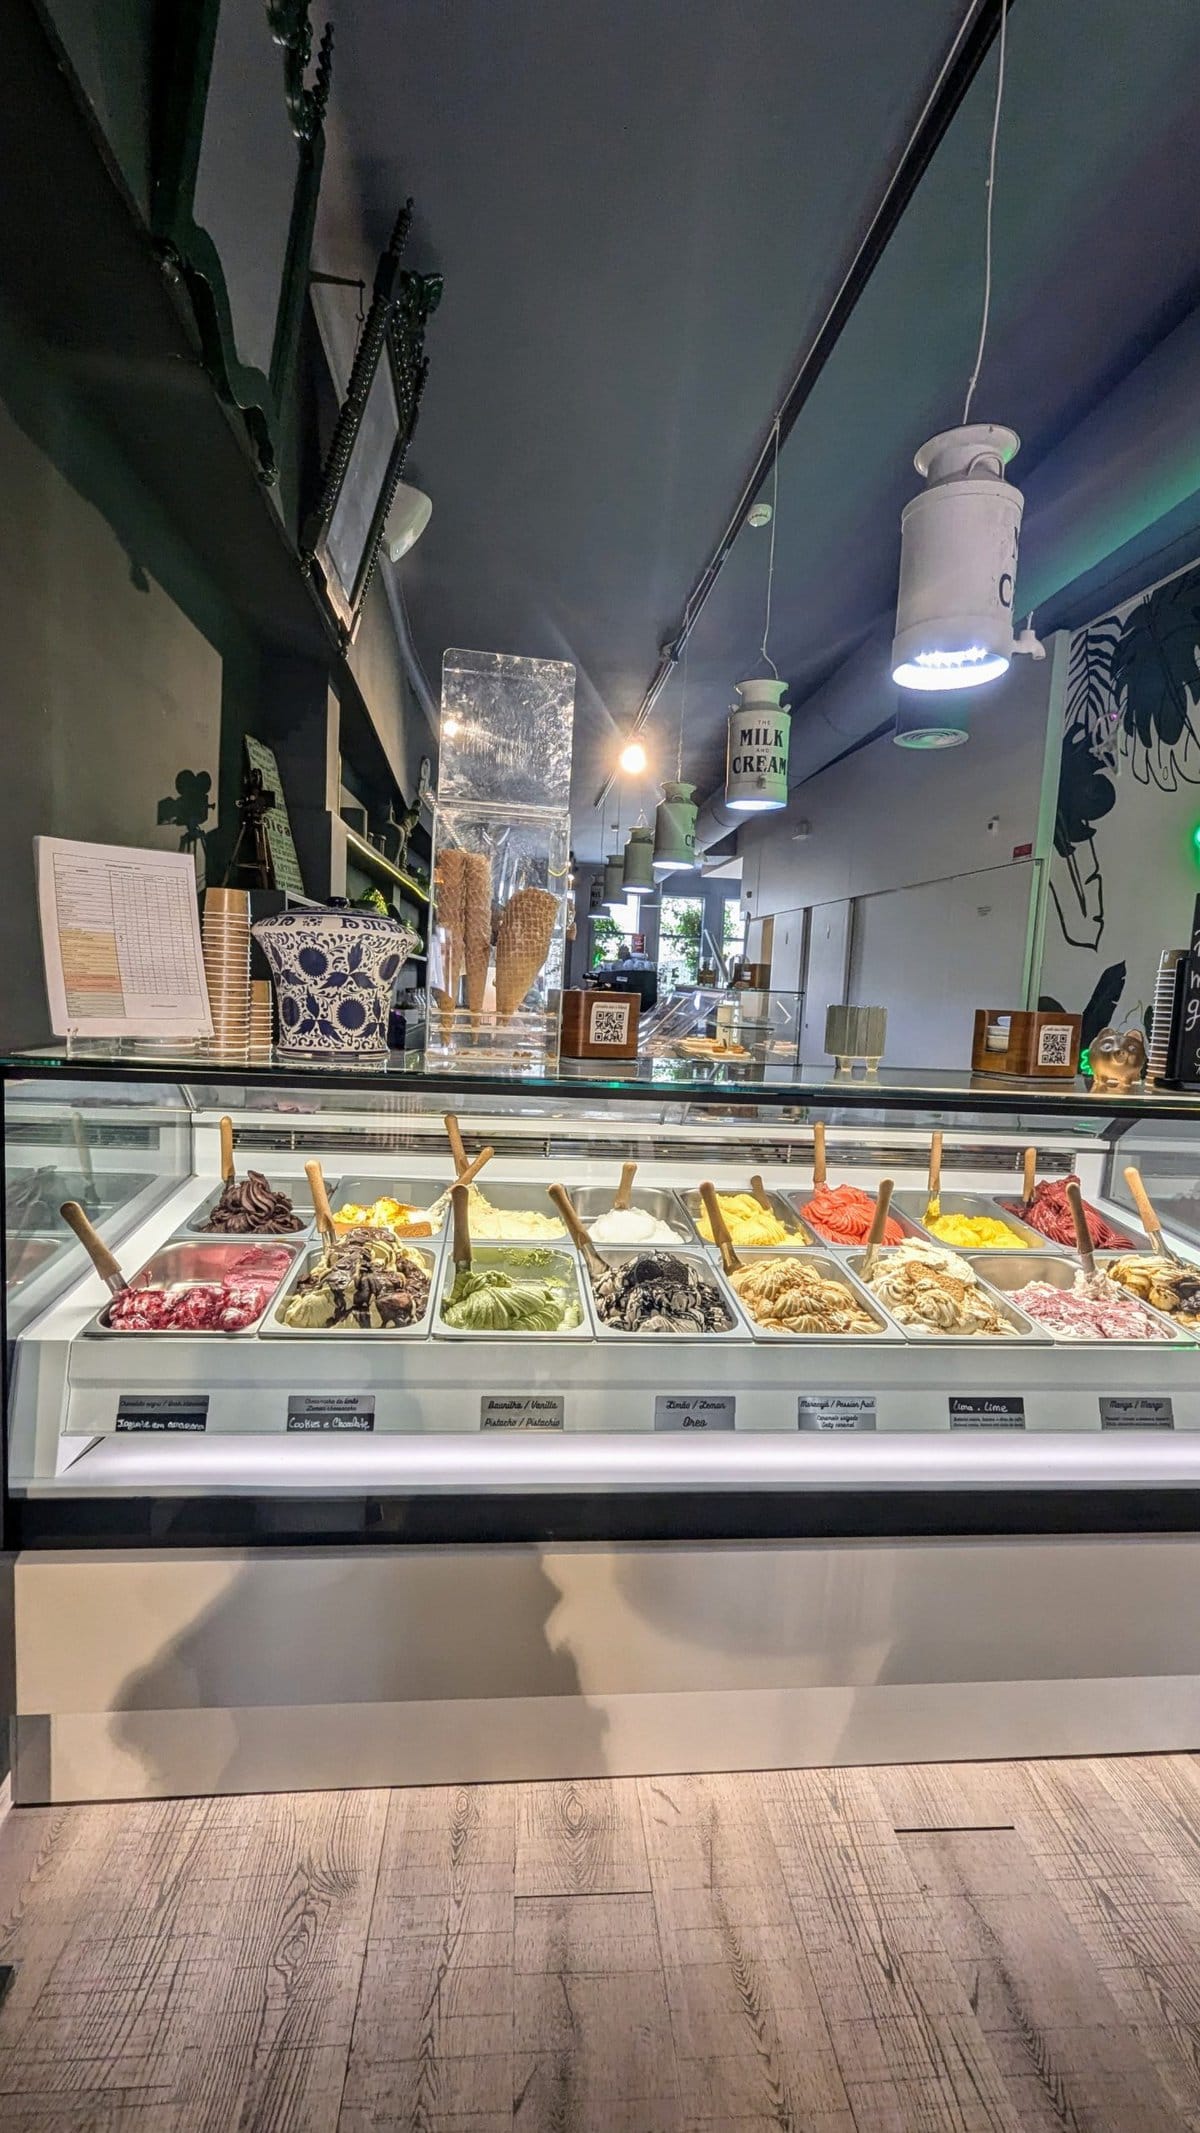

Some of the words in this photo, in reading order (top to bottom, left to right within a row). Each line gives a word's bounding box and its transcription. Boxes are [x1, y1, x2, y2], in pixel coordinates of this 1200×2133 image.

[740, 727, 784, 748] MILK
[732, 755, 787, 775] CREAM
[984, 1401, 1008, 1413] Lime
[289, 1417, 321, 1429] Cookies
[682, 1416, 707, 1428] Oreo
